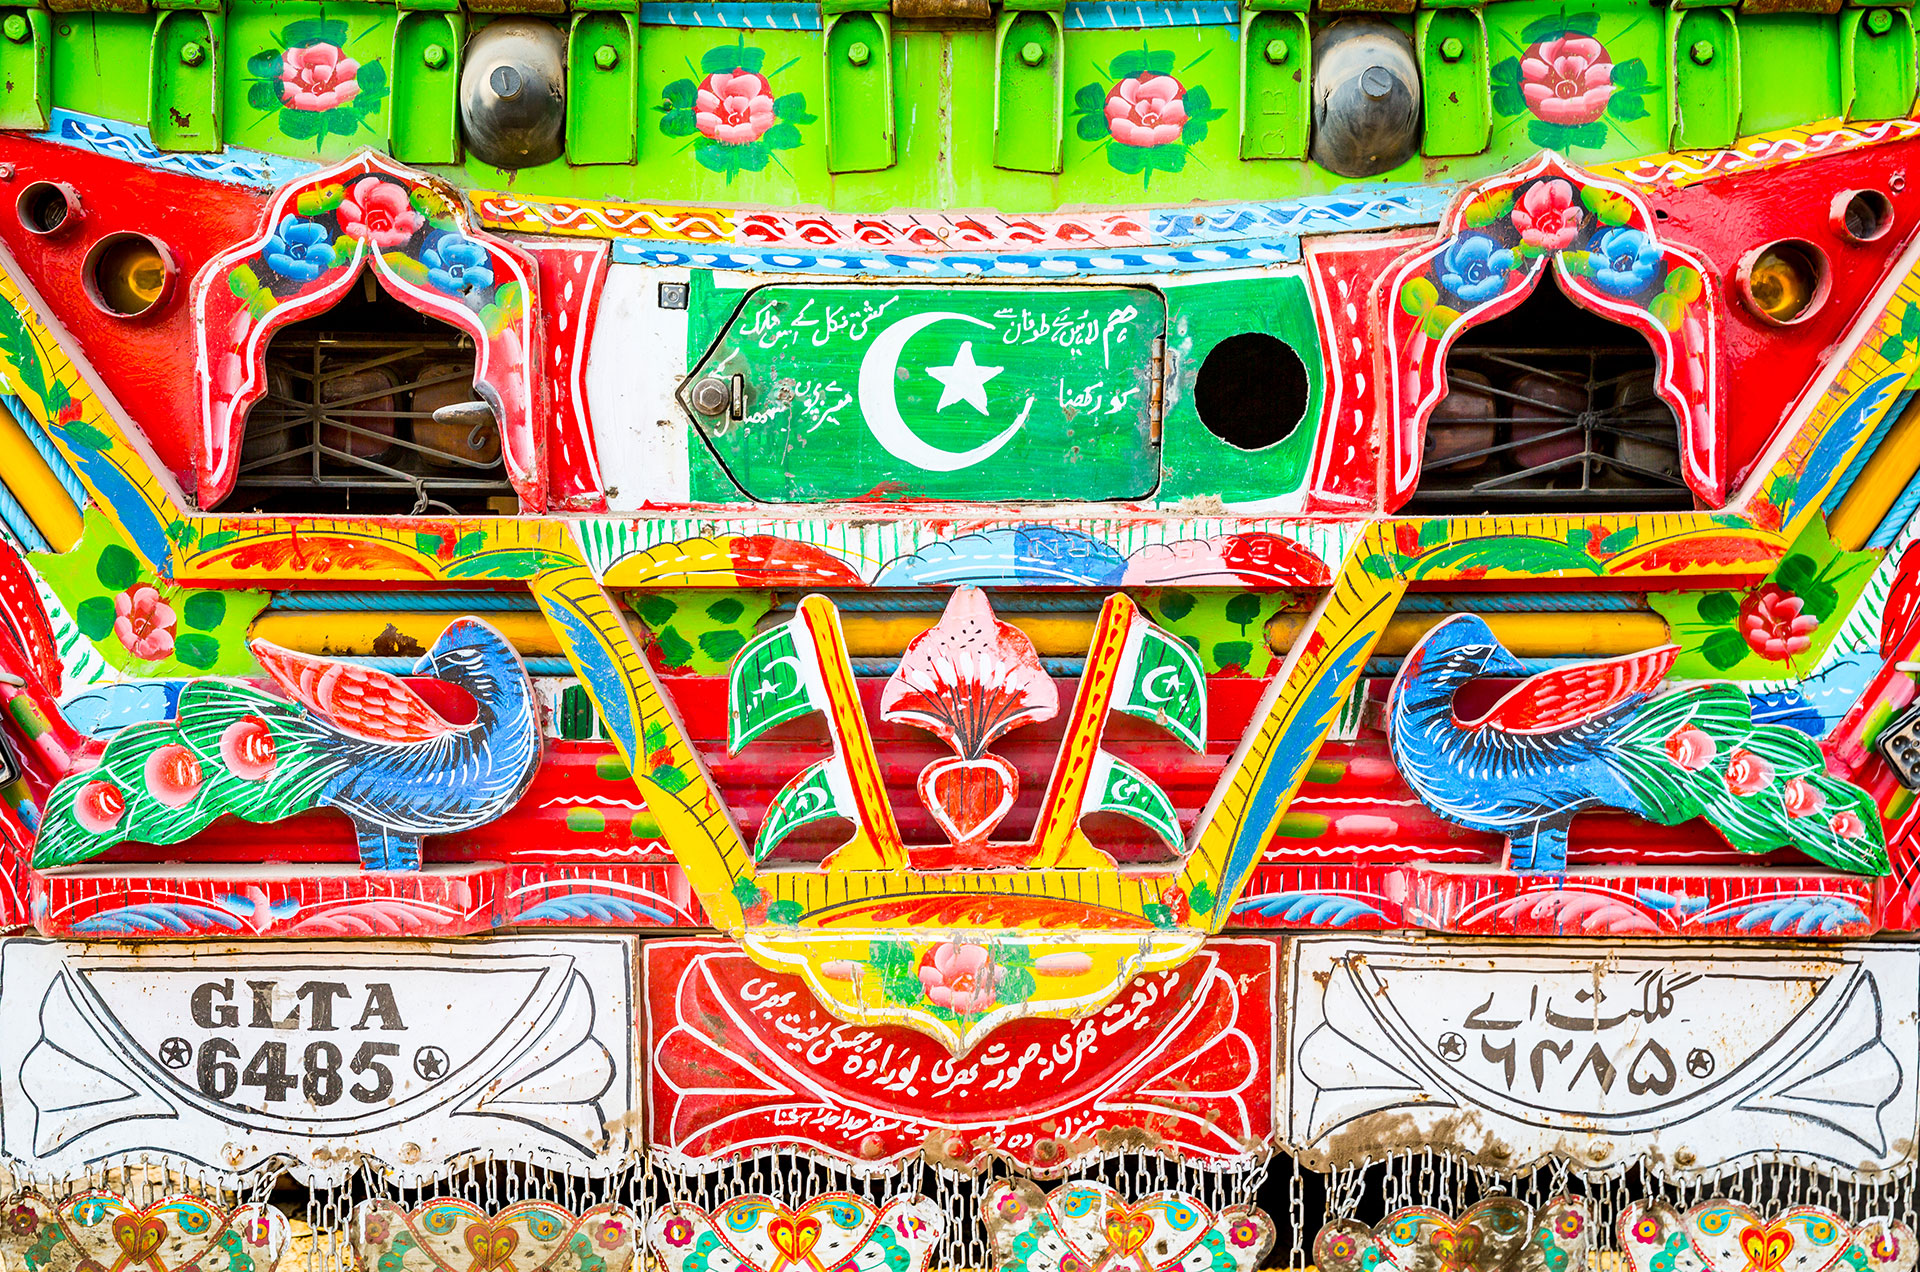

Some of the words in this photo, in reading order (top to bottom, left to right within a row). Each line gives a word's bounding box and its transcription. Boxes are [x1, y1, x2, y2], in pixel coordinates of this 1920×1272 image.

[790, 298, 820, 327] کے
[849, 295, 900, 341] کشتی
[806, 380, 853, 433] میرے
[1059, 377, 1104, 415] رکھنا
[1103, 387, 1141, 415] کو
[190, 978, 408, 1032] GLTA
[1463, 984, 1538, 1031] اے
[1545, 967, 1703, 1032] گلگت
[196, 1036, 400, 1106] 6485
[980, 1043, 1041, 1092] صورت
